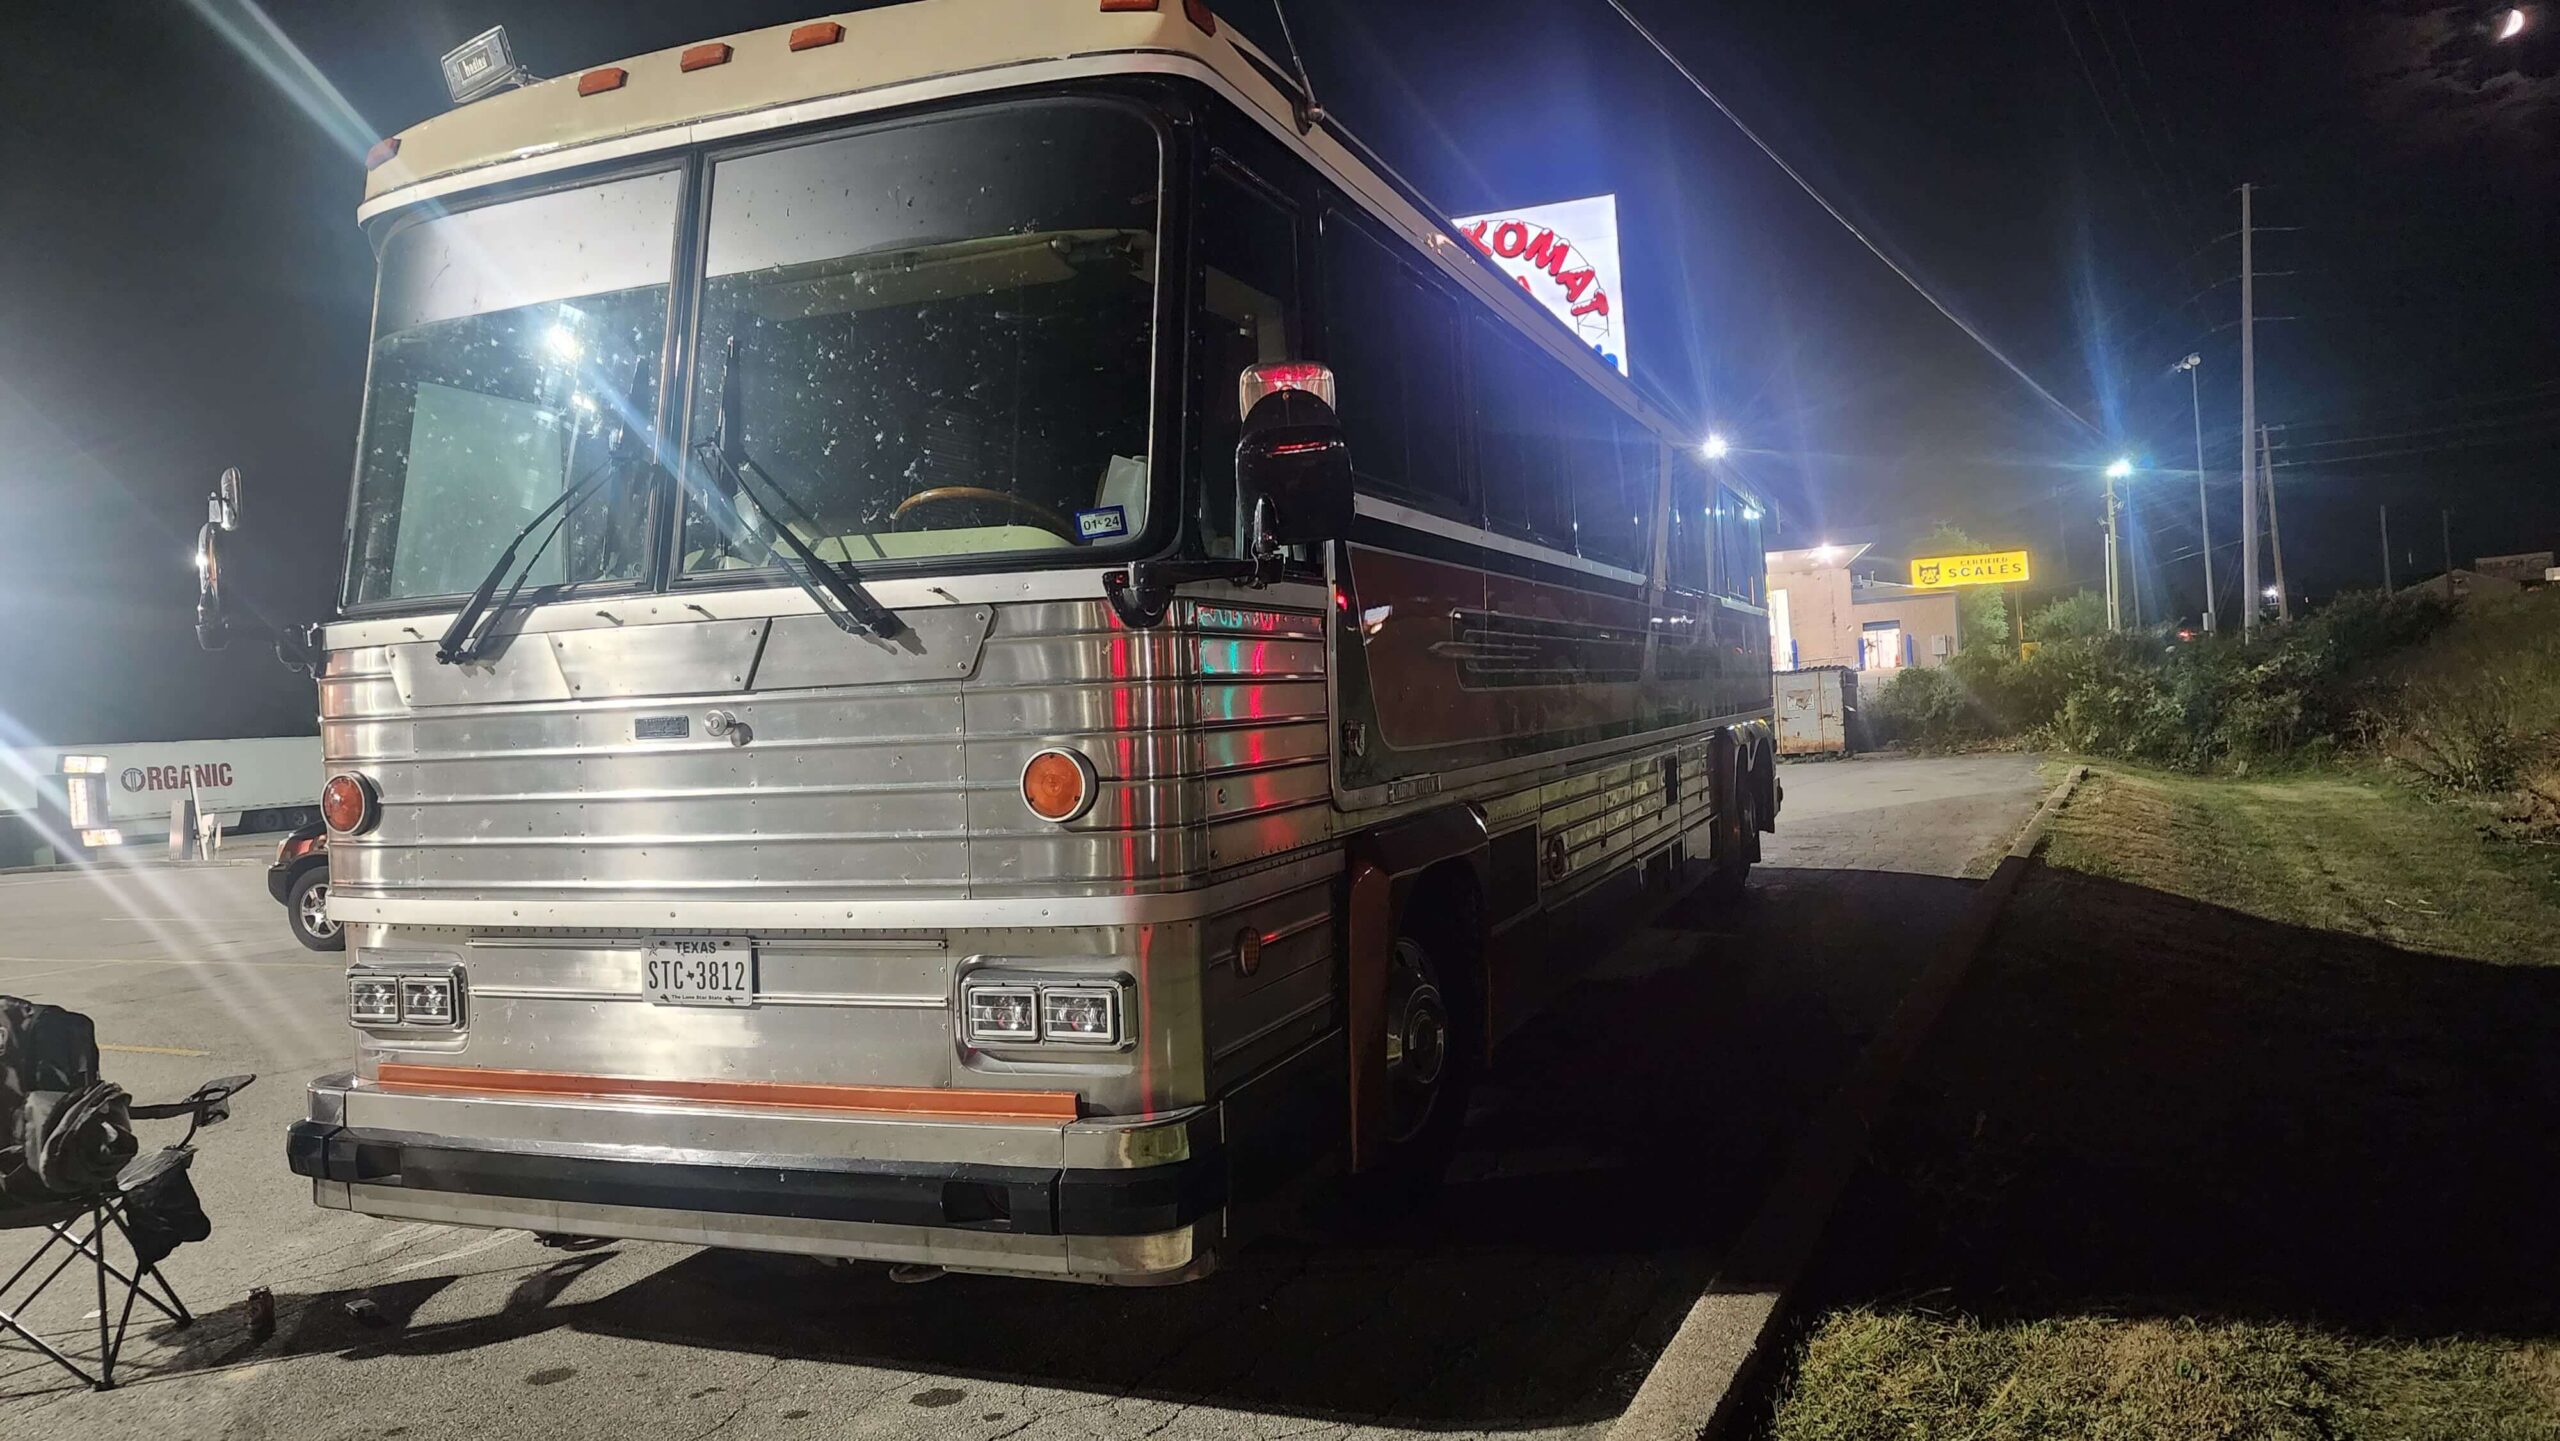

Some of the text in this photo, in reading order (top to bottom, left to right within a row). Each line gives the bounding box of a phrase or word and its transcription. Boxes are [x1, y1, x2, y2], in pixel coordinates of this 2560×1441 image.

[1083, 516, 1119, 531] 01 24
[1960, 557, 2008, 566] CERTIFIED
[1948, 563, 2022, 578] SCALES
[120, 762, 233, 793] ORGANIC
[674, 941, 717, 954] TEXAS
